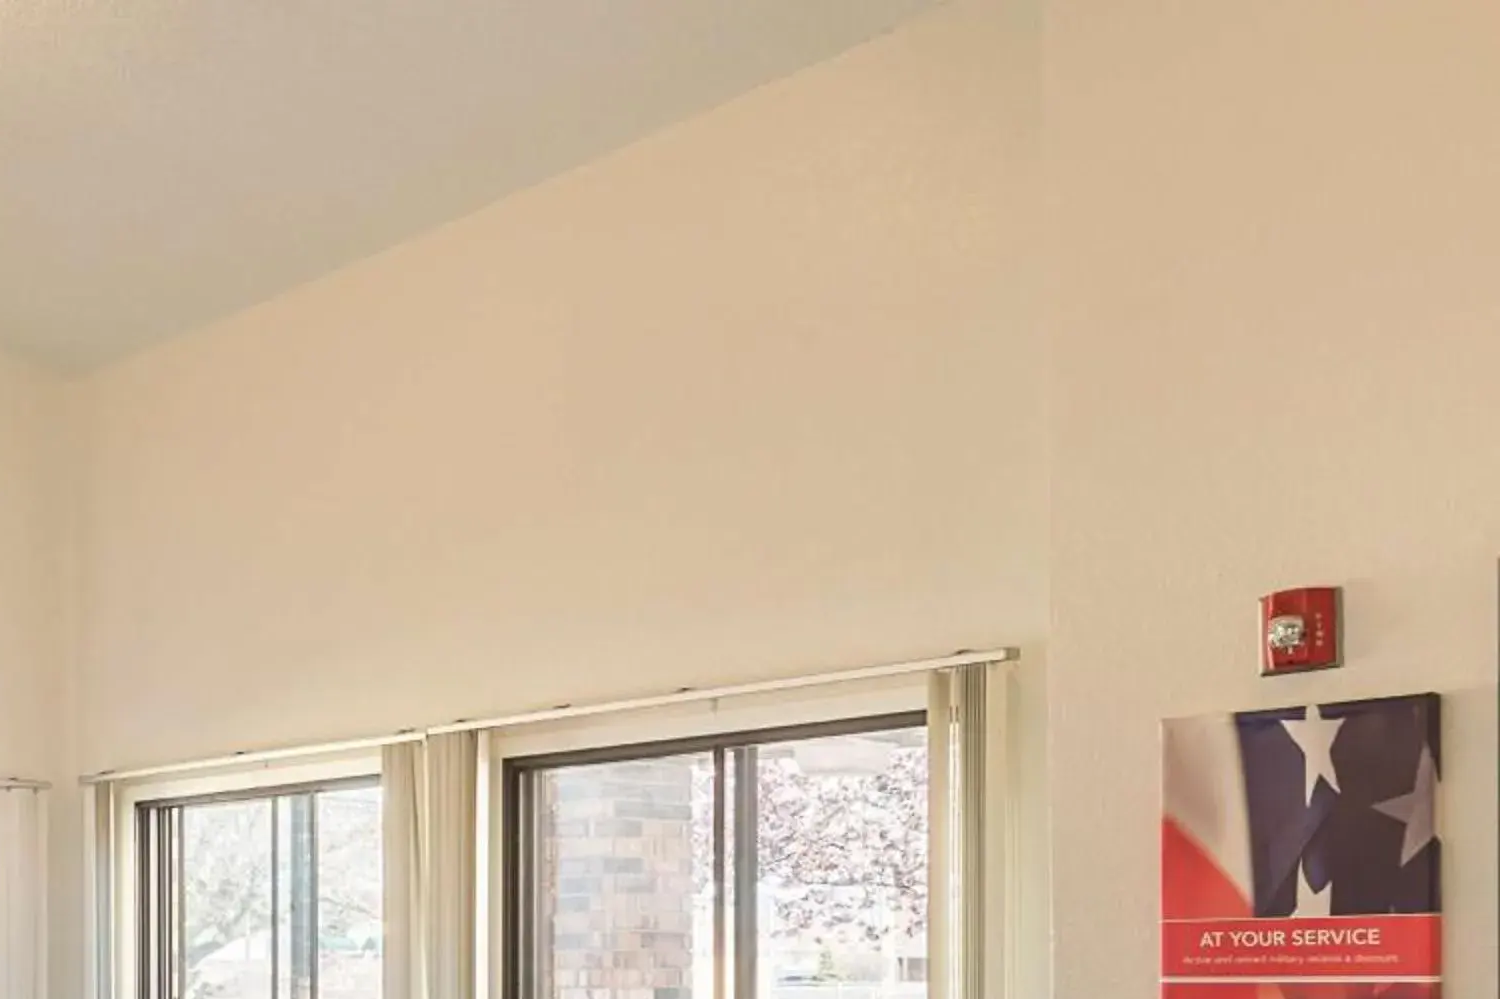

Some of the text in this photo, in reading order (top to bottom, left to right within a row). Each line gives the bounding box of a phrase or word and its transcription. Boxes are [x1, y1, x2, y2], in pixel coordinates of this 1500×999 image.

[1200, 928, 1381, 948] AT YOUR SERVICE
